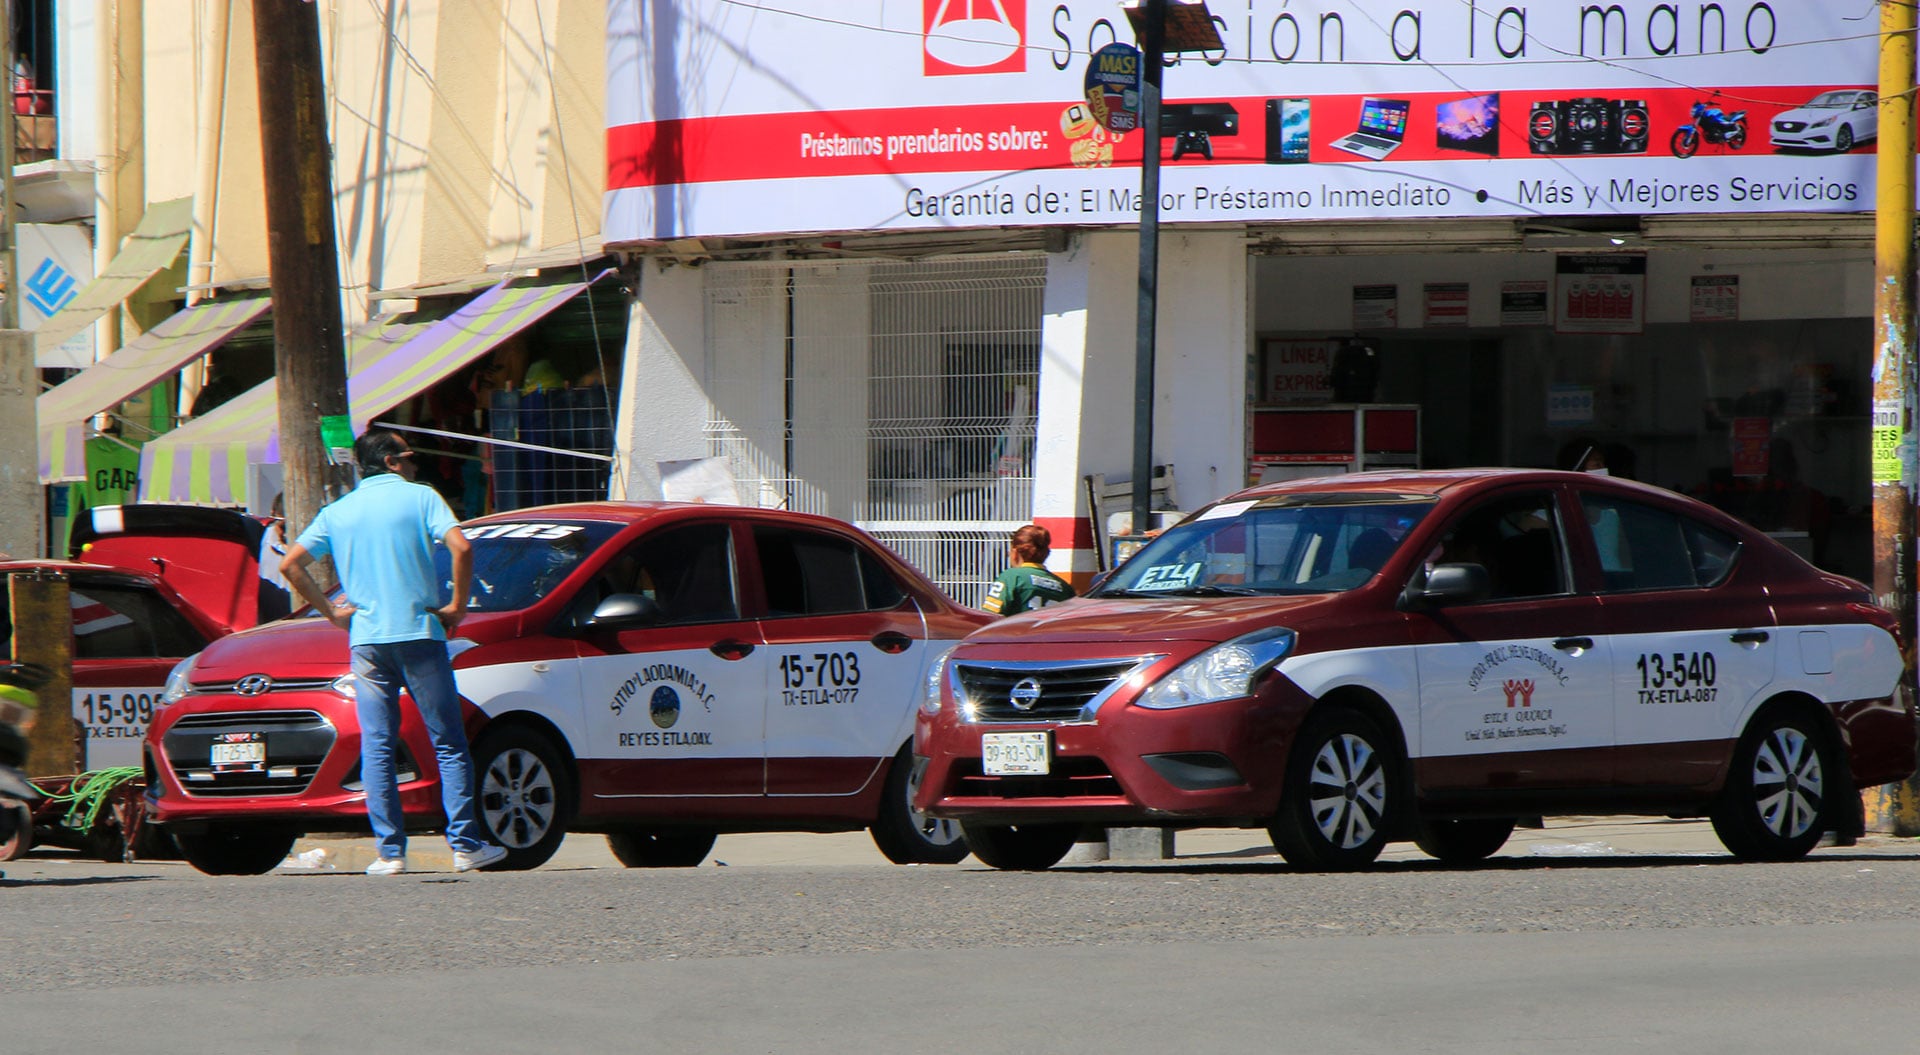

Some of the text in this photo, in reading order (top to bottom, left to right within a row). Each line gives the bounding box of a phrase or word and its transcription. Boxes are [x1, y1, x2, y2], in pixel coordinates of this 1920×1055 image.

[1391, 9, 1421, 61] a
[1469, 0, 1526, 58] la
[1579, 1, 1776, 56] mano
[1110, 116, 1135, 129] SMS
[801, 125, 1049, 160] Préstamos prendarios sobre:
[905, 176, 1858, 217] Garantía de: El Maor Préstamo Inmediato Más y Mejores Servicios
[1280, 344, 1328, 364] LÍNEA
[95, 467, 137, 492] GAP
[1134, 562, 1201, 589] ETLA
[779, 652, 861, 688] 15-703
[1637, 651, 1716, 688] 13-540
[781, 687, 859, 706] TX-ETLA-077
[1637, 687, 1718, 705] TX-ETLA-087
[619, 732, 660, 747] REYES
